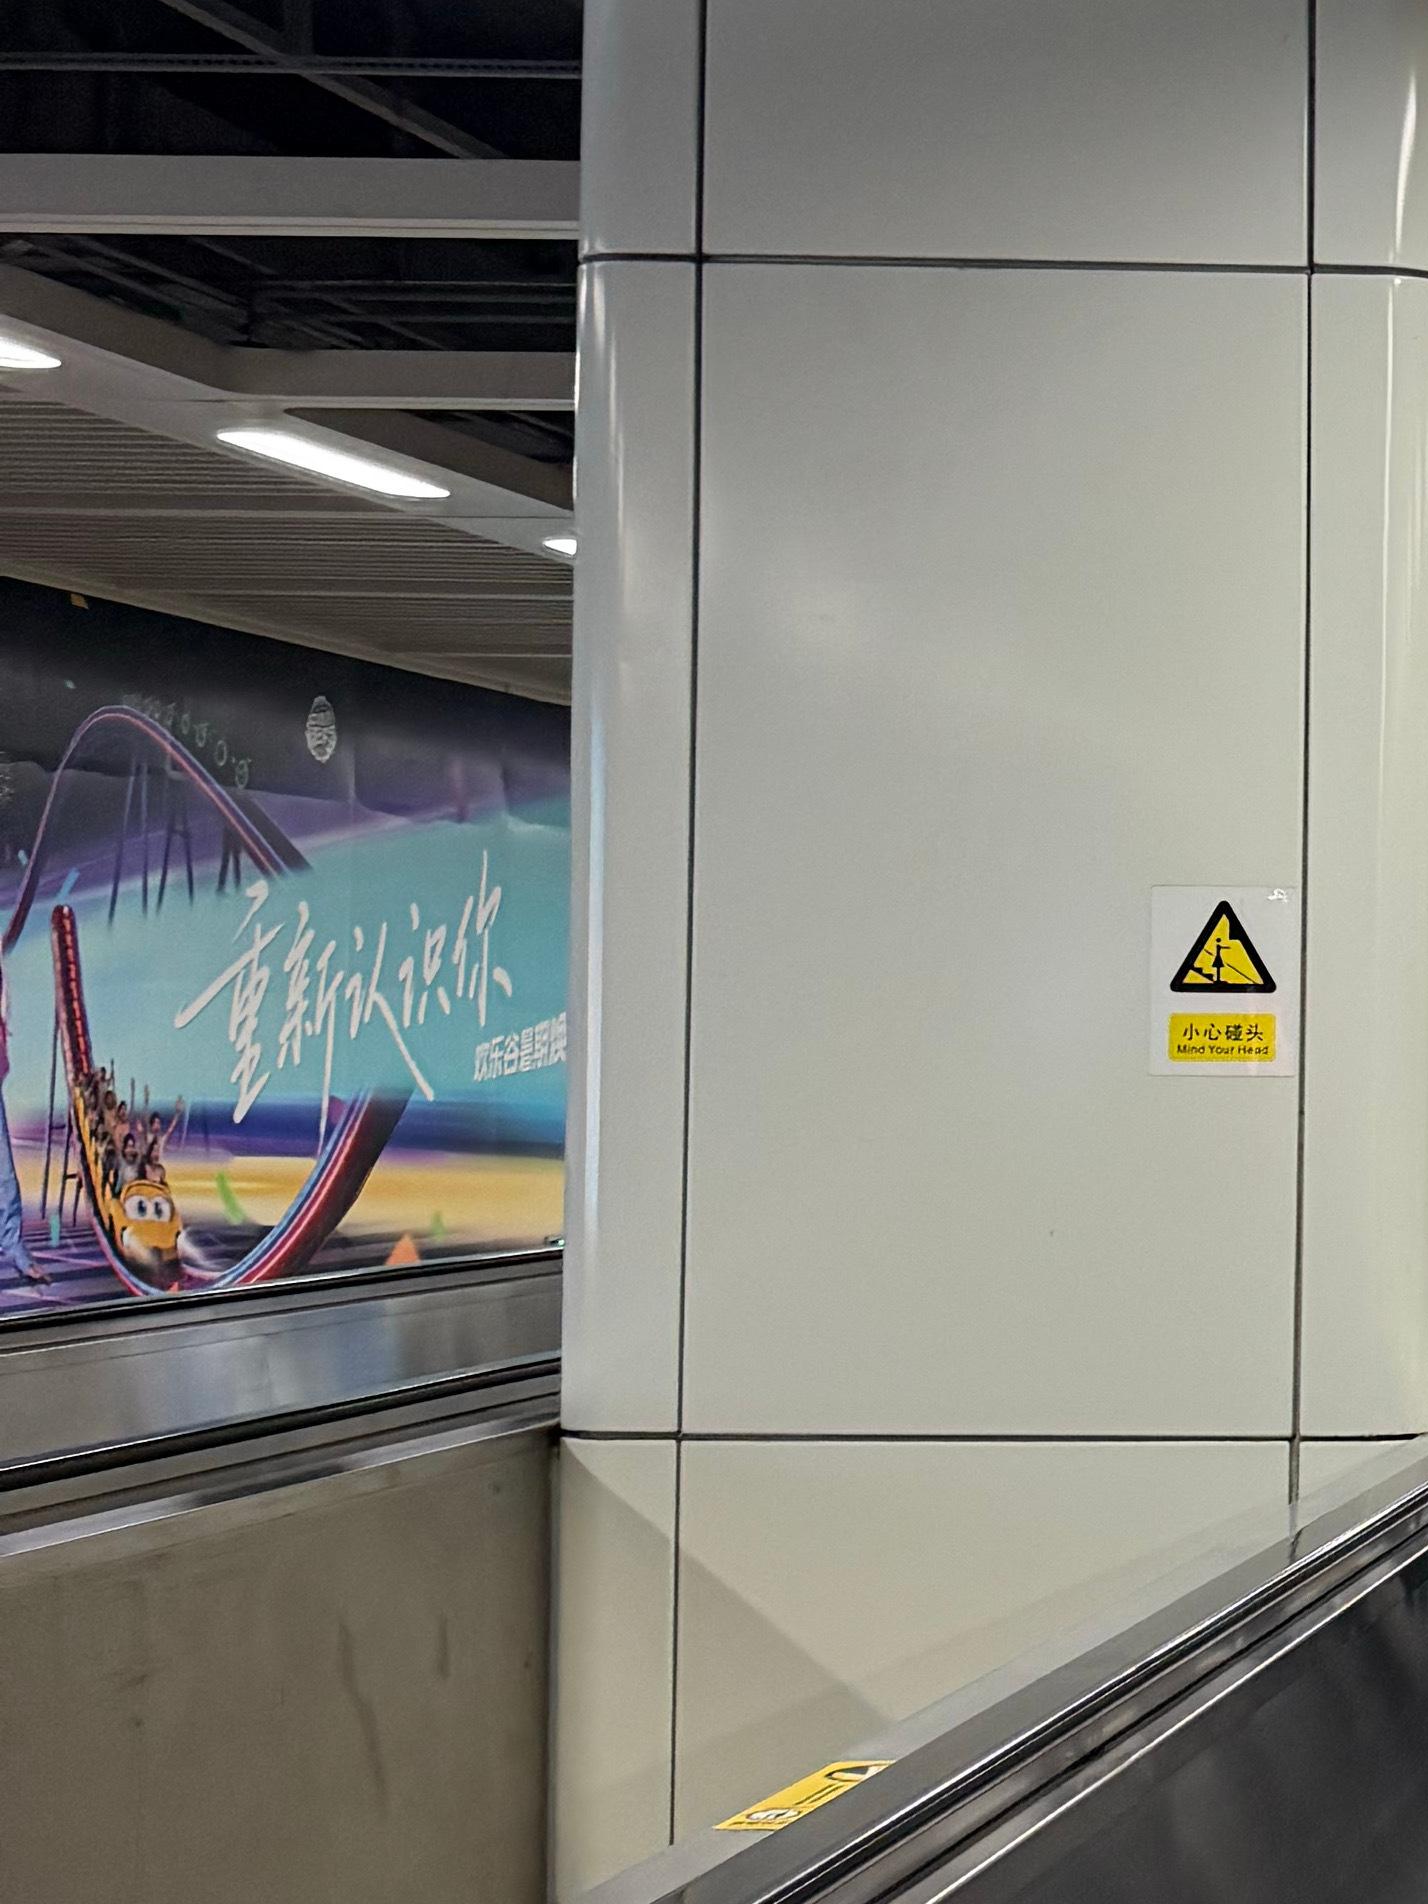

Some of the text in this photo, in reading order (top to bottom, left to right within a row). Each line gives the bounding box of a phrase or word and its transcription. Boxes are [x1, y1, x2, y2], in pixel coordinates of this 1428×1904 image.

[173, 850, 513, 1162] 重新认识你
[1183, 1022, 1264, 1042] 小心碰头
[1176, 1045, 1269, 1056] Mind Your Head
